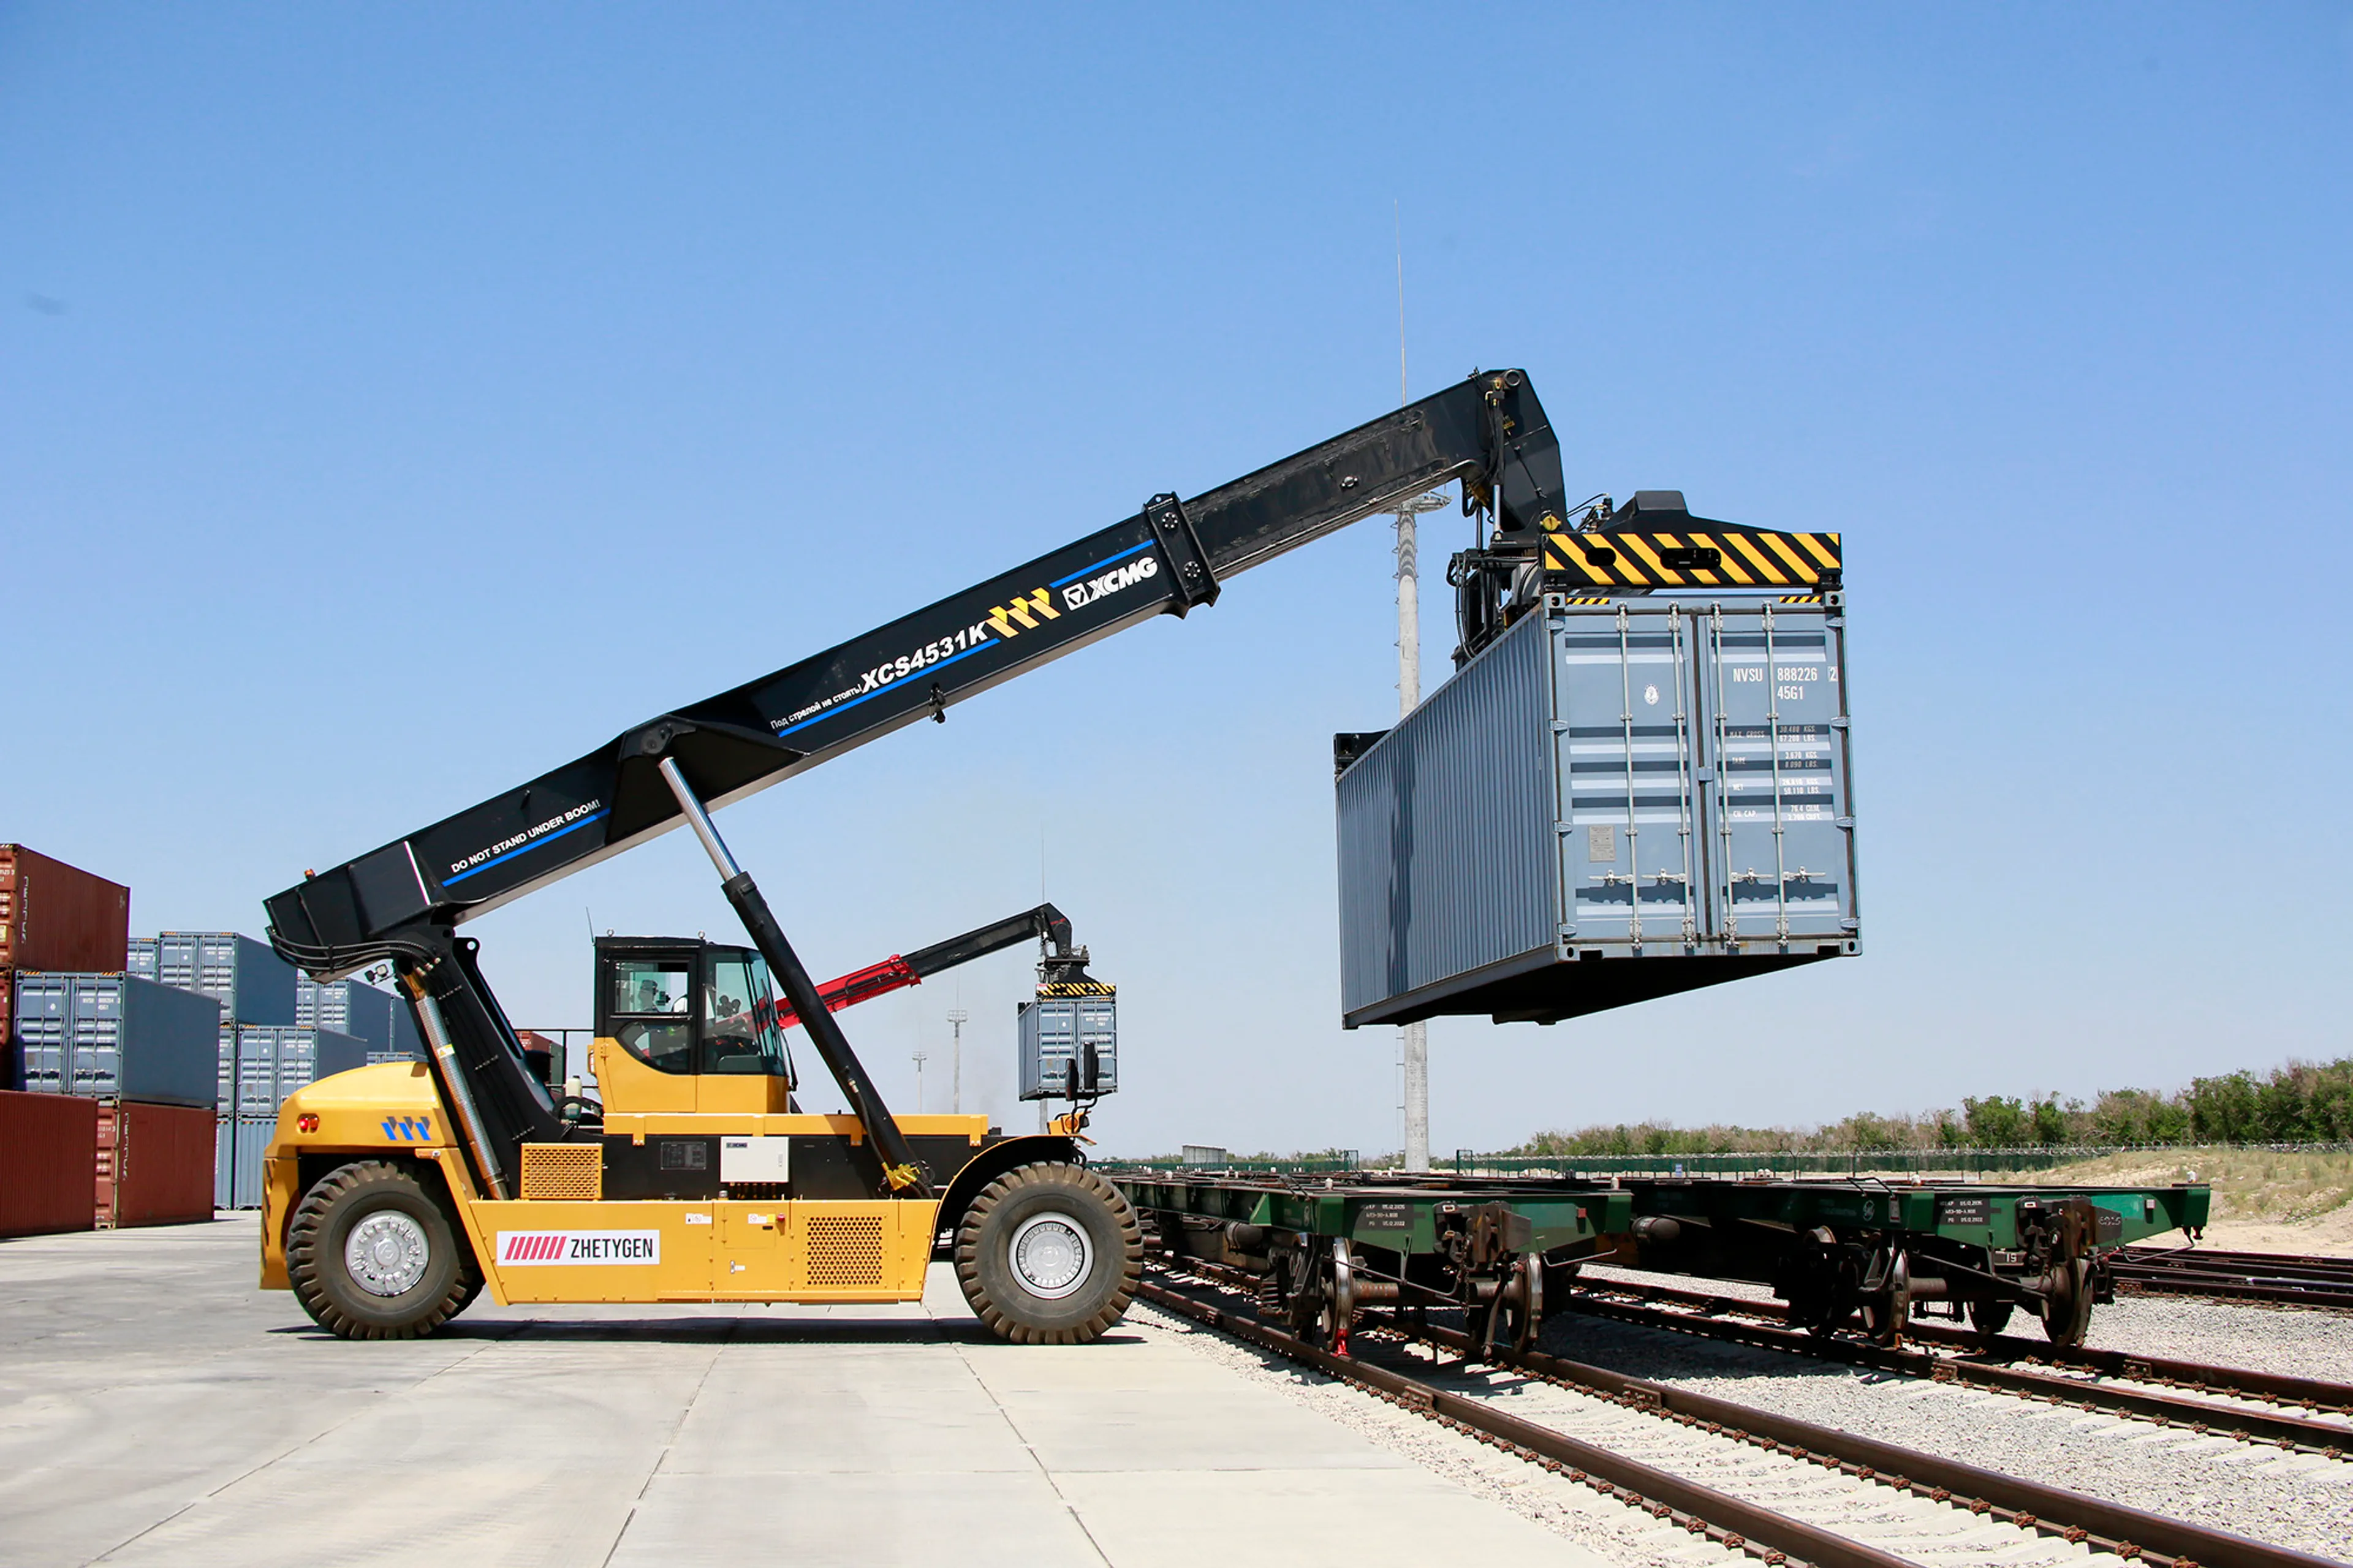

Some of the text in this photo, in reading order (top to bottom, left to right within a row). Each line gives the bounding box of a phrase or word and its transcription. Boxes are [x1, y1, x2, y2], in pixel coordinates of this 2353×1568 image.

[1087, 557, 1158, 602] XCMG
[860, 621, 988, 694] XCS4531K
[1733, 666, 1838, 682] NVSU 888226 2
[770, 683, 862, 729] Под стрелой не стоять!
[1777, 686, 1803, 700] 45G1
[450, 799, 601, 873] DO NOT STAND UNDER BOOM!
[570, 1238, 653, 1258] ZHETYGEN
